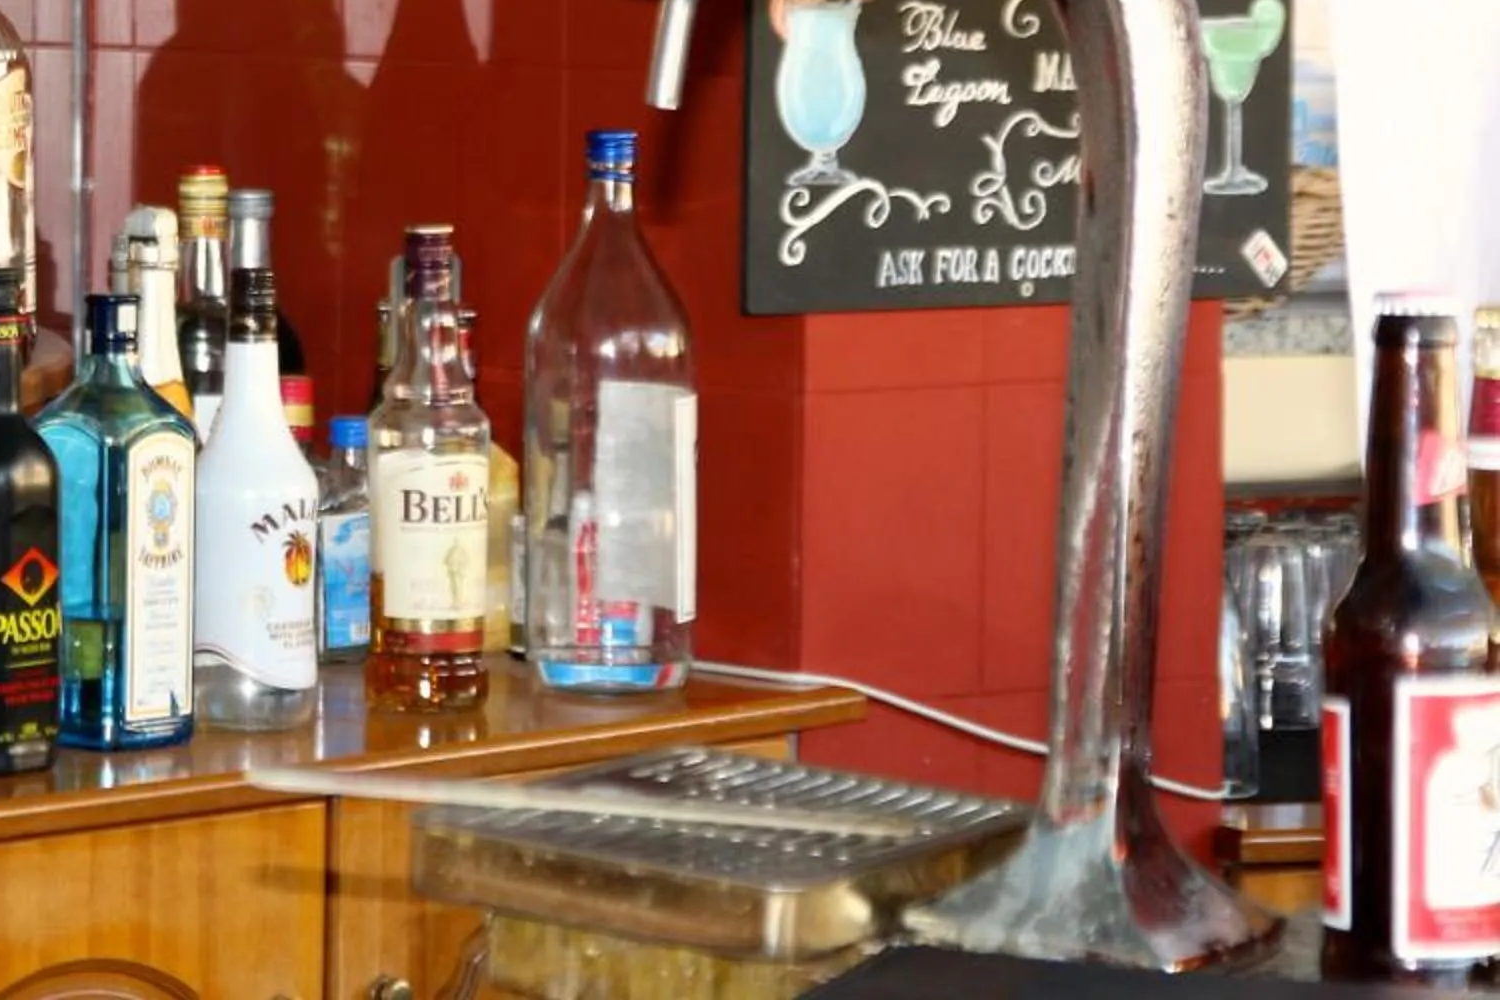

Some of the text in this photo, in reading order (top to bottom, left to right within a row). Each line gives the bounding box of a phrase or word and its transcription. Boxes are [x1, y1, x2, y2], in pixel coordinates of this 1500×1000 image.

[898, 0, 987, 53] Blue
[902, 57, 1012, 128] Lagoon
[875, 249, 926, 288] ASK
[931, 247, 979, 284] FOR
